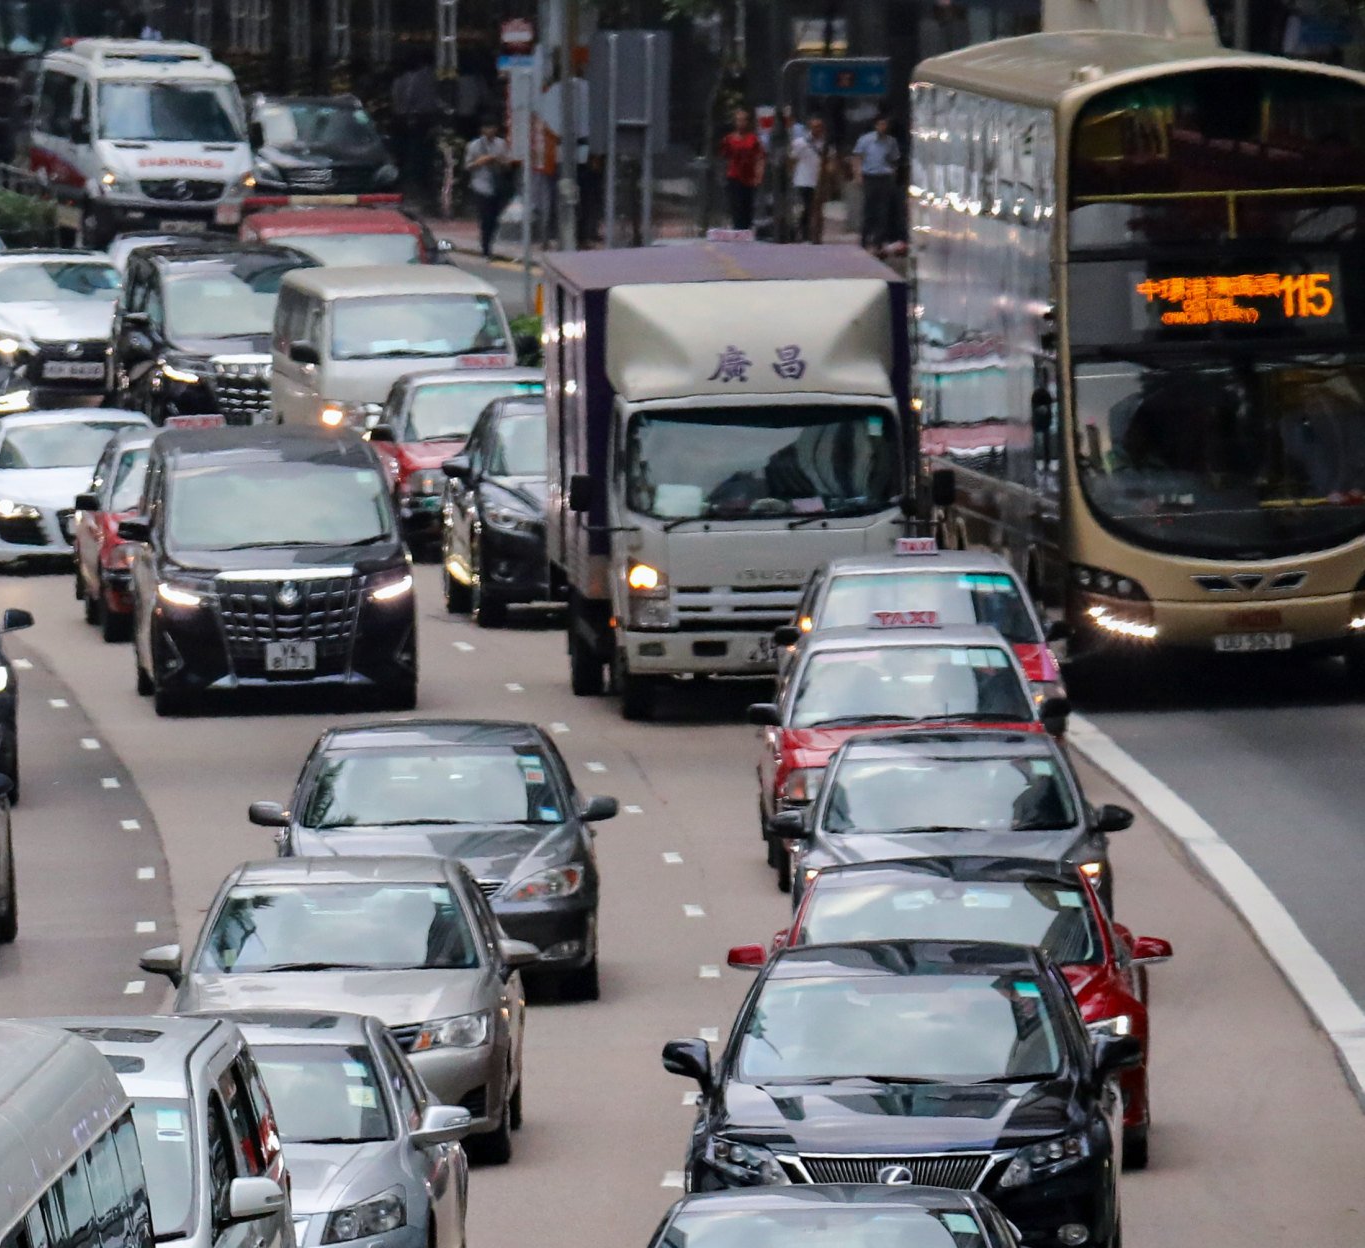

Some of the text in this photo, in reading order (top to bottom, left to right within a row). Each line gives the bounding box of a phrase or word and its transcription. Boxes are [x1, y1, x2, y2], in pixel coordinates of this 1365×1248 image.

[1280, 274, 1333, 317] 115
[706, 344, 805, 383] 廣昌
[874, 611, 936, 625] TAXI
